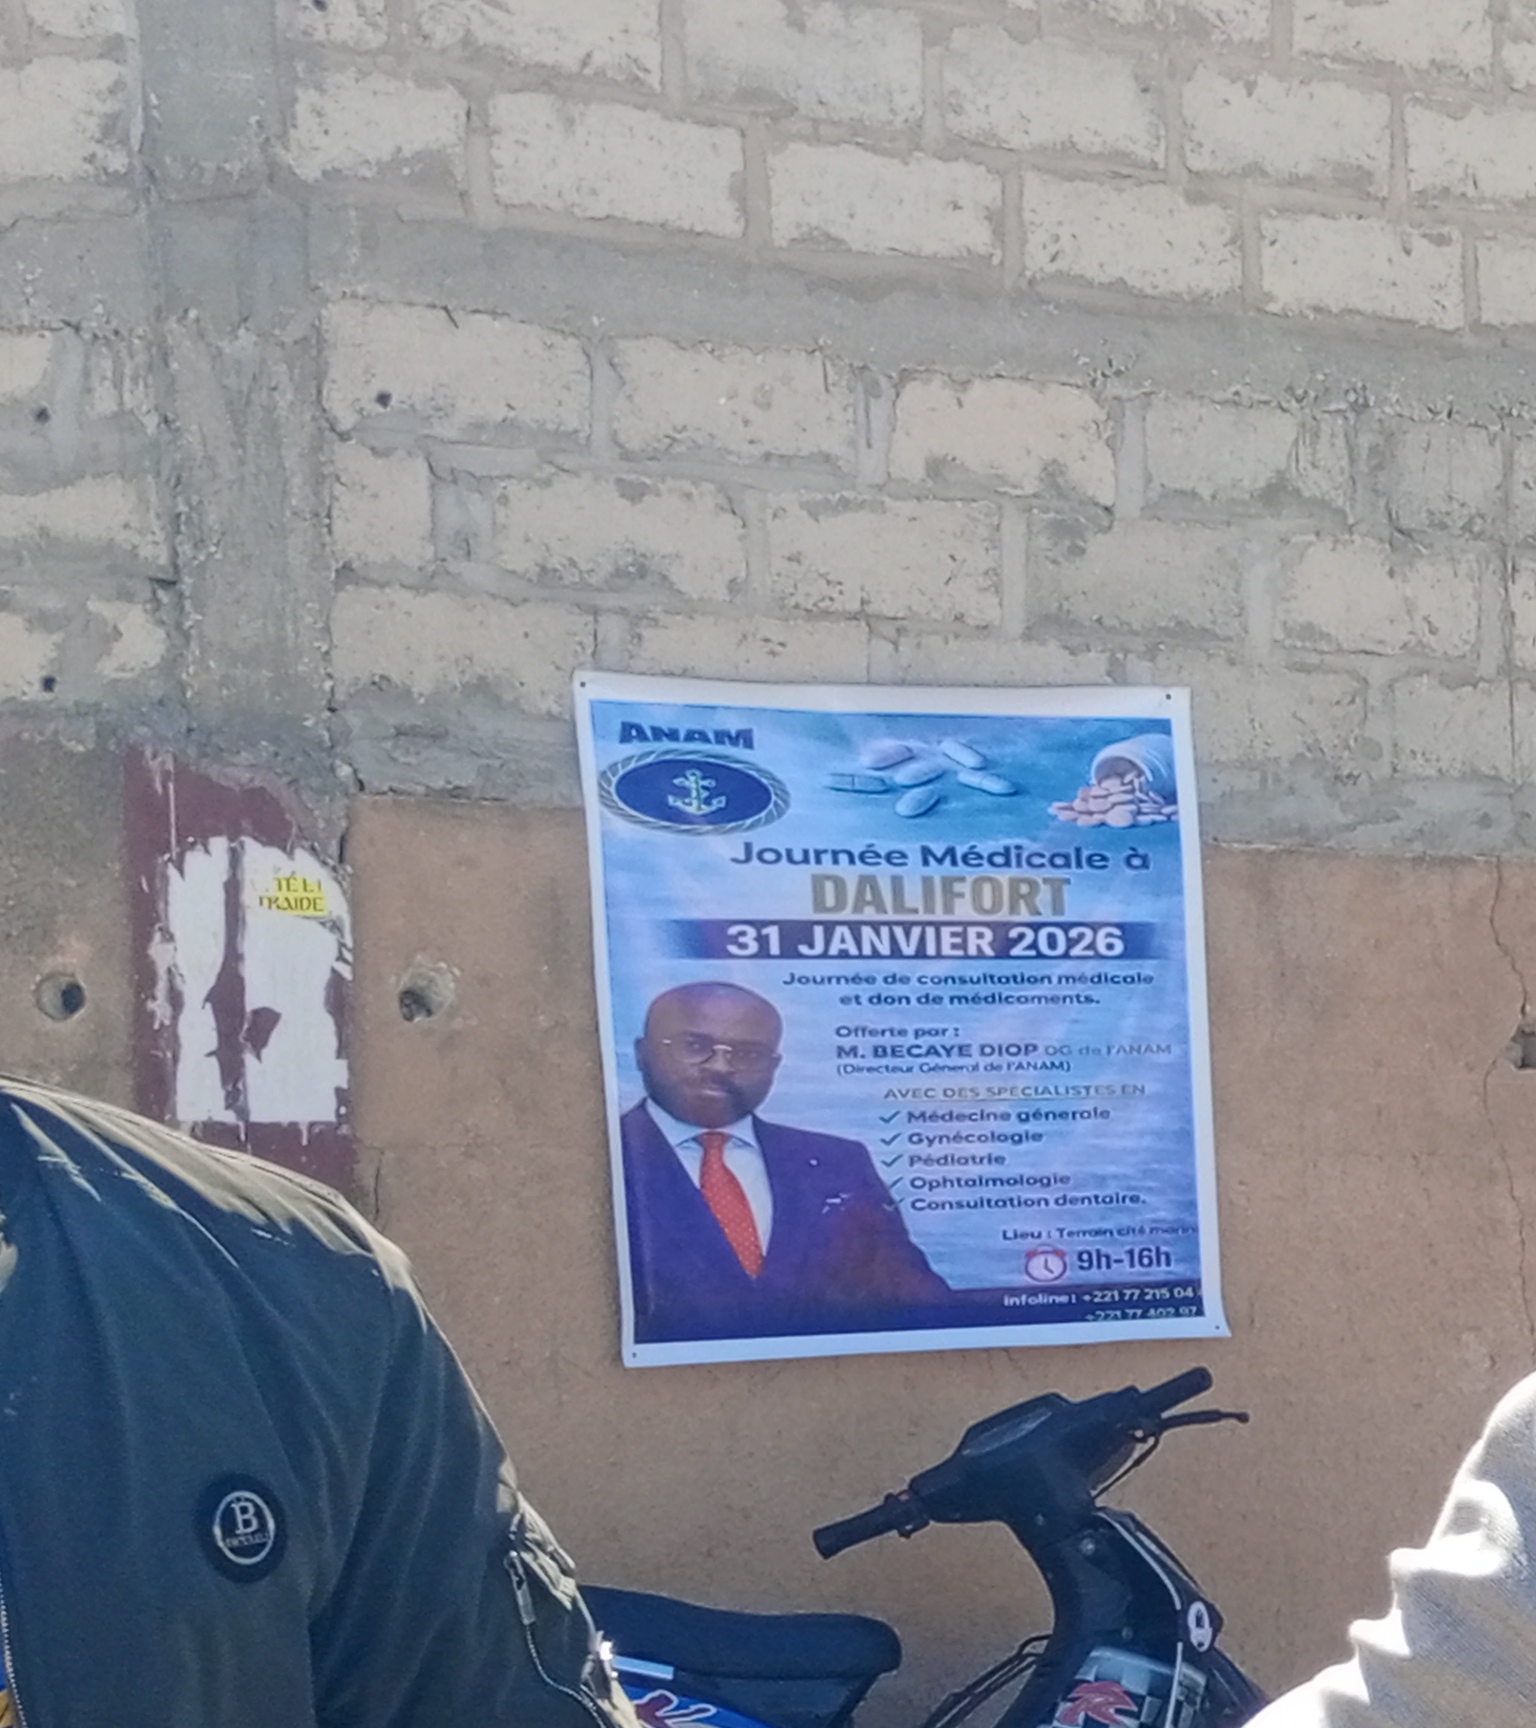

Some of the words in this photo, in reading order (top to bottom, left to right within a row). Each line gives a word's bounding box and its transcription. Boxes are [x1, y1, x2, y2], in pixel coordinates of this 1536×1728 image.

[618, 721, 754, 750] ANAM
[730, 841, 909, 867] Journée
[920, 845, 1109, 870] Médicale
[1124, 846, 1150, 870] à
[811, 874, 1070, 917] DALIFORT
[726, 924, 780, 957] 31
[797, 924, 995, 957] JANVIER
[1008, 925, 1124, 957] 2026
[782, 972, 877, 986] Journée
[883, 972, 911, 986] de
[917, 972, 1053, 987] consultation
[1057, 972, 1155, 987] médicale
[839, 994, 862, 1006] et
[868, 992, 911, 1006] don
[916, 992, 944, 1006] de
[949, 991, 1100, 1006] médicaments.
[835, 1025, 908, 1038] Offerte
[914, 1027, 949, 1040] par
[836, 1045, 866, 1059] M.
[873, 1044, 972, 1059] BECAYE
[978, 1043, 1039, 1059] DIOP
[884, 1088, 937, 1099] AVEC
[942, 1087, 980, 1099] DES
[1121, 1084, 1146, 1097] EN
[907, 1109, 1011, 1124] Médecine
[907, 1130, 1044, 1147] Gynécologie
[908, 1153, 1007, 1168] Pédiatrie
[909, 1173, 1071, 1192] Ophtalmologie
[910, 1195, 1049, 1211] Consultation
[1054, 1192, 1147, 1208] dentaire.
[1002, 1229, 1043, 1241] Lieu
[1076, 1246, 1172, 1271] 9h-16h
